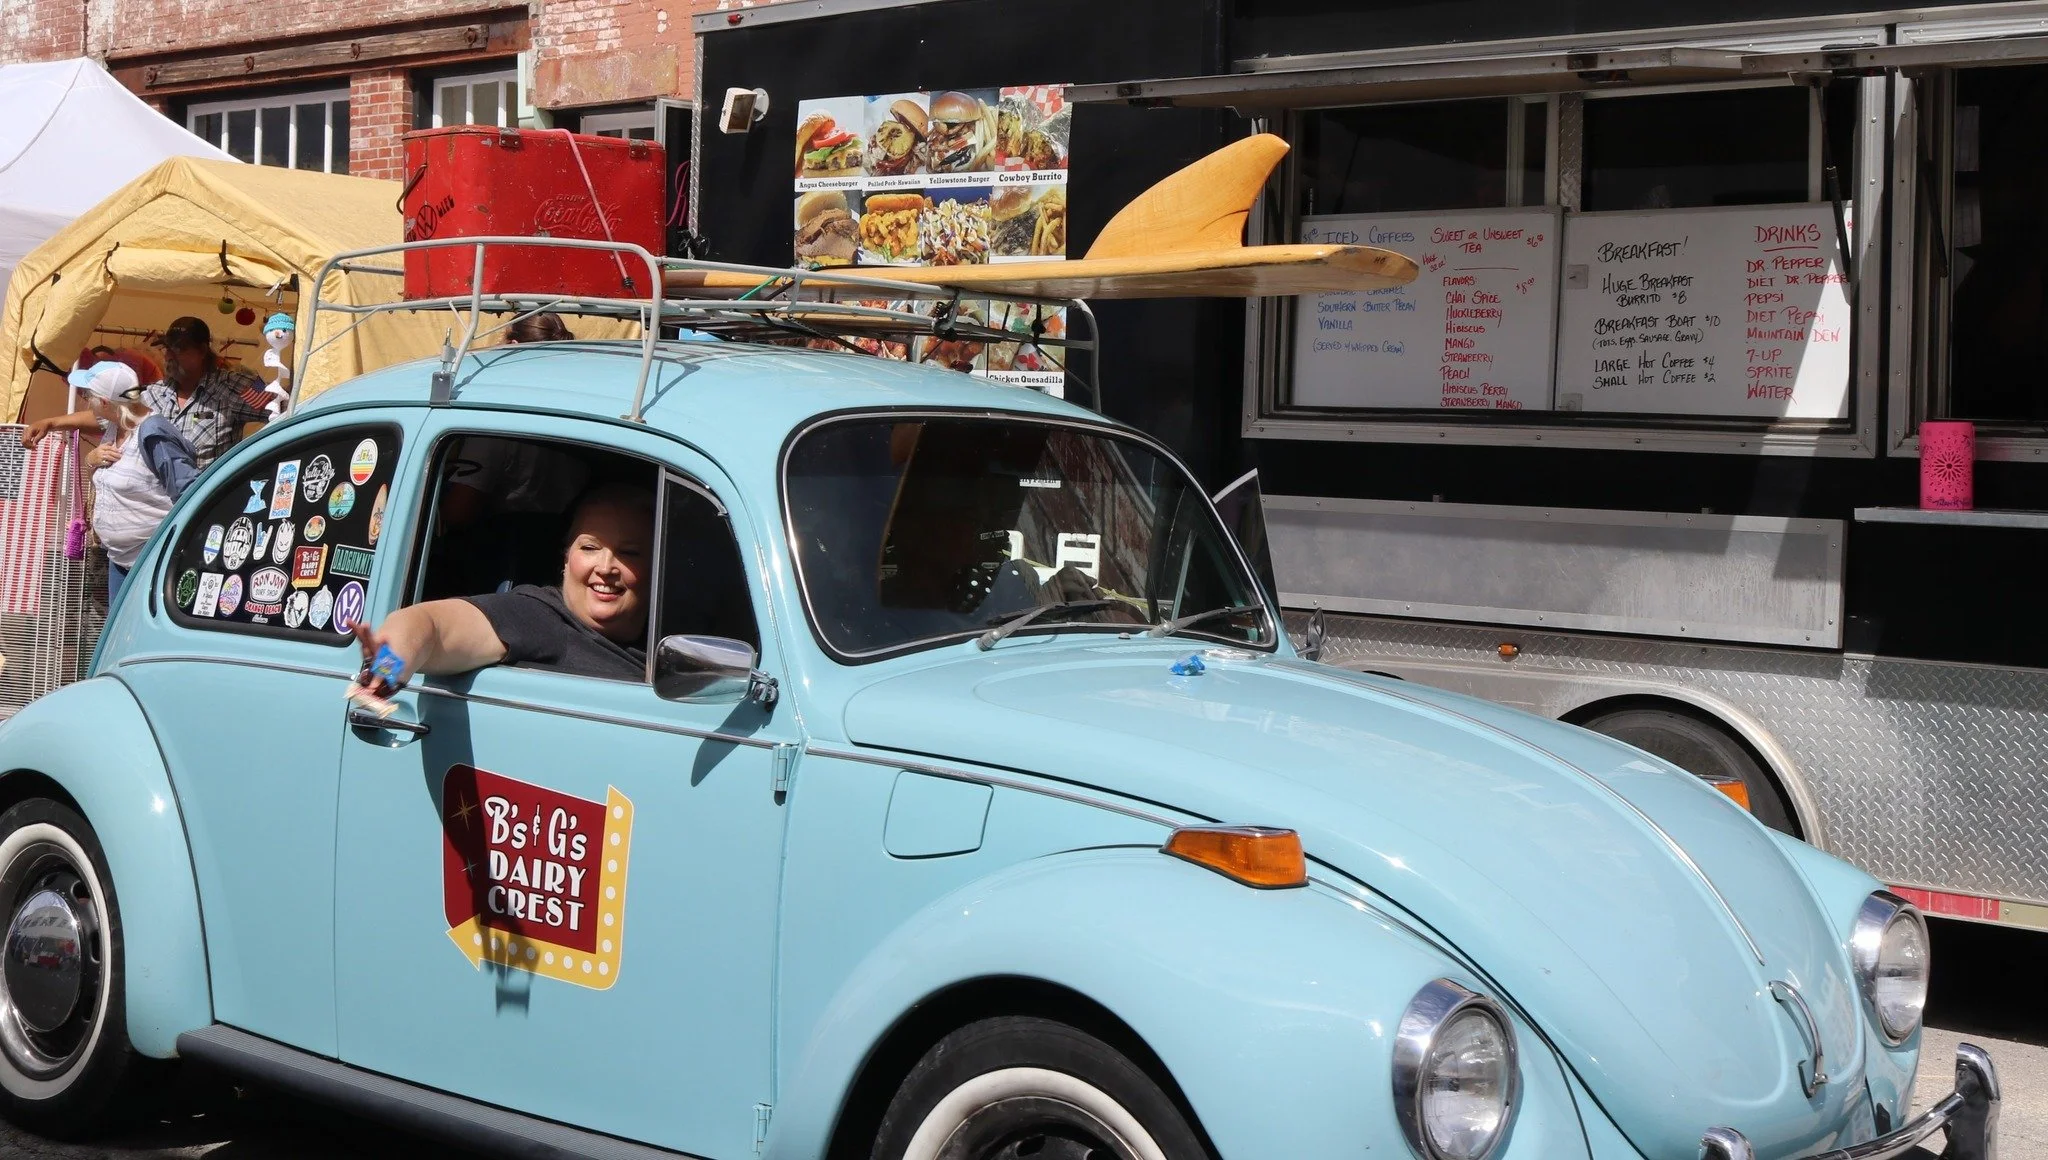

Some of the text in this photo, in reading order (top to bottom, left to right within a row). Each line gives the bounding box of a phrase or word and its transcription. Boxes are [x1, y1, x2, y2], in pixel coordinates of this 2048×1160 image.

[967, 175, 990, 184] Burger
[998, 172, 1063, 183] Cowboy Burrito
[1323, 231, 1359, 244] ICED
[1369, 226, 1415, 243] COFFEES
[1430, 227, 1465, 243] SWEET
[1483, 228, 1524, 241] UNSWEET
[1753, 223, 1821, 243] DRINKS
[1458, 242, 1482, 254] TEA
[1598, 236, 1688, 263] BREAKFAST!
[1772, 255, 1824, 269] PEPPER
[1602, 273, 1694, 295] HUGE BREAKFAST
[1746, 277, 1776, 288] DIET
[1804, 272, 1849, 284] PEPPER
[1446, 290, 1500, 304] CHAI SPICE
[1616, 290, 1688, 307] BURRITO $8
[1744, 290, 1784, 306] PEPSI
[1317, 299, 1416, 314] SOUTHERN BUTTER PECAN
[1318, 316, 1353, 330] VANILLA
[1446, 305, 1502, 328] HUCKLEBERRY
[1746, 305, 1825, 325] DIET PEPSI
[1594, 315, 1721, 335] BREAKFAST BOAT $10
[1445, 337, 1475, 350] MANGO
[1441, 351, 1493, 371] STRAWBERRY
[1595, 350, 1715, 373] LARGE HOT COFFEE $4
[1746, 348, 1782, 363] 7-UP
[1020, 375, 1063, 384] Quesadilla
[1439, 365, 1470, 380] PEACH
[1592, 369, 1716, 390] SMALL HOT COFFEE $2
[1746, 366, 1793, 379] SPRITE
[1480, 383, 1508, 398] BERRY
[1747, 380, 1797, 405] WATER
[1496, 399, 1522, 409] MANGO
[253, 573, 285, 589] RON JON
[484, 796, 528, 849] B's
[548, 807, 588, 861] G's
[488, 850, 587, 898] DAIRY
[487, 885, 584, 931] CREST
